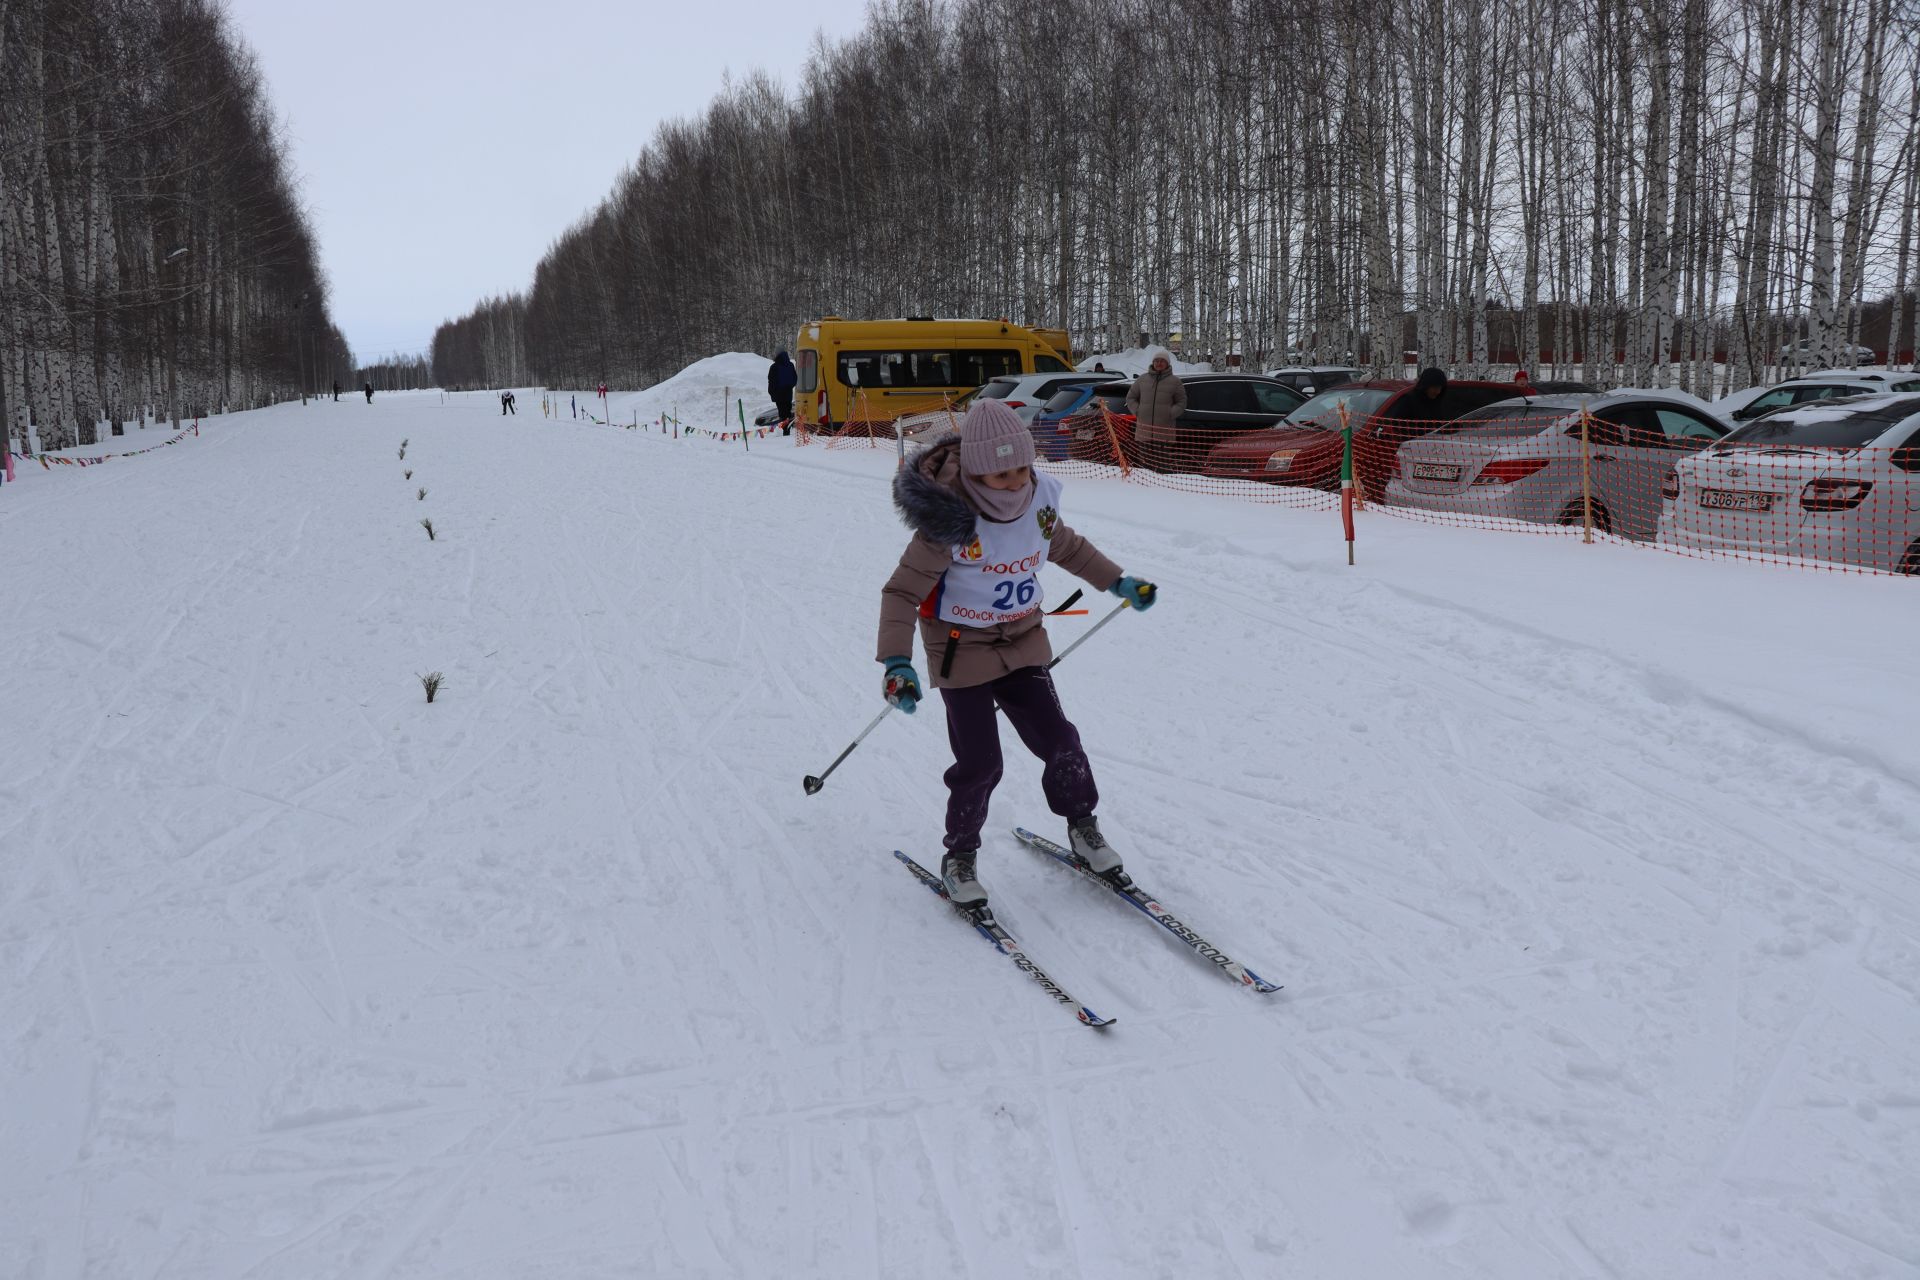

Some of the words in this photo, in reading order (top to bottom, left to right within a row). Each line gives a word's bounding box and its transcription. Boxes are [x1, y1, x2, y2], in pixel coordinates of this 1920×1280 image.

[992, 578, 1035, 610] 26
[1156, 914, 1235, 970] ROSSIGNOL
[1011, 952, 1074, 1005] ROSSIGNOL
